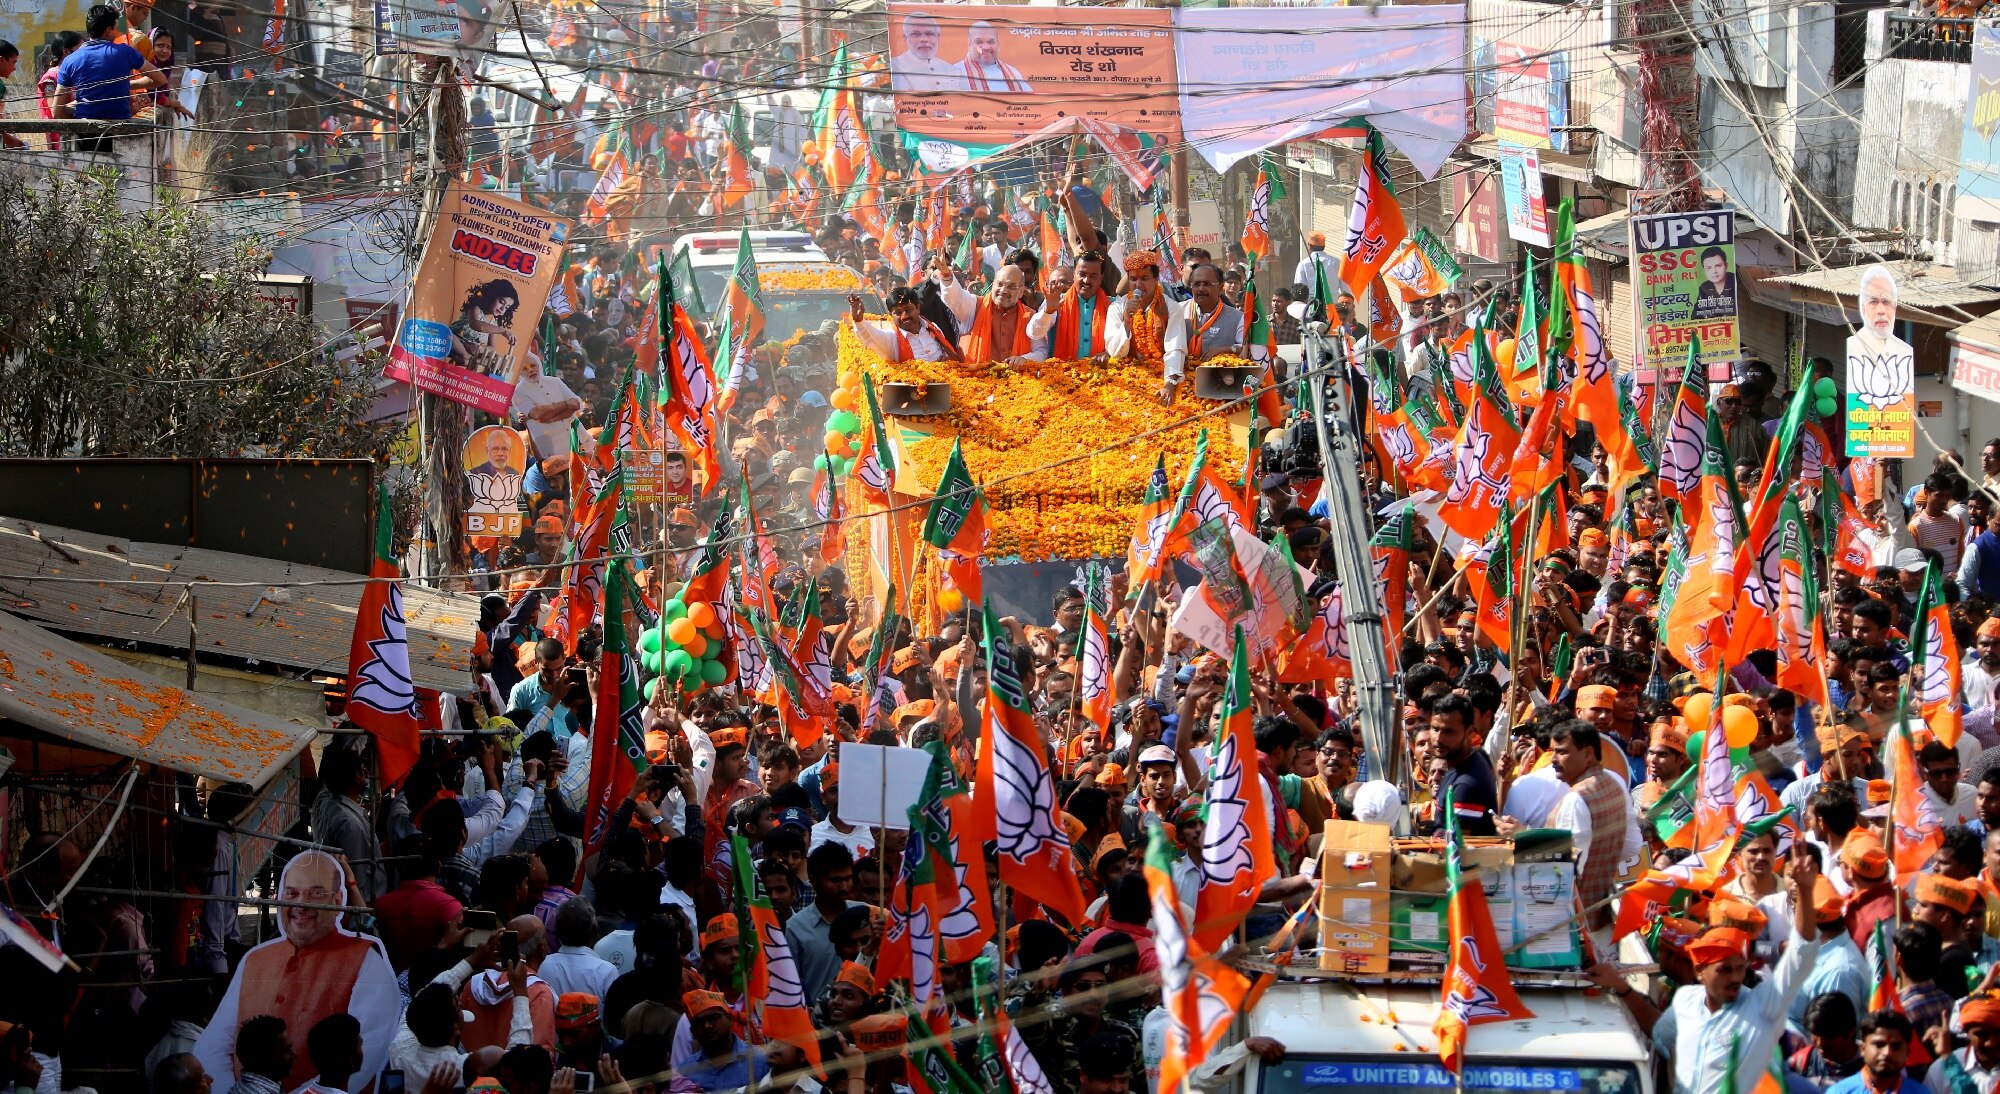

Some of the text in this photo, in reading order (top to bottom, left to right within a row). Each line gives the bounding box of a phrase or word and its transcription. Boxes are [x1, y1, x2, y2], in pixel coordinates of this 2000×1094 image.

[1039, 41, 1145, 57] विजय शंखनाद
[1070, 58, 1117, 72] रोड शो
[461, 194, 521, 220] ADMISSION
[451, 213, 553, 256] READINESS PROGRAMMES
[491, 214, 511, 228] CLASS
[512, 222, 541, 239] SCHOOL
[1639, 214, 1728, 250] UPSI
[451, 229, 538, 277] KIDZEE
[1639, 249, 1698, 273] SSC
[1646, 273, 1674, 286] BANK
[1646, 322, 1734, 347] मिशन
[1849, 407, 1883, 424] परिवर्तन
[1849, 429, 1873, 442] कमल
[468, 515, 520, 533] BJP
[1352, 1067, 1420, 1084] UNITED
[1425, 1069, 1556, 1088] AUOMOBILES
